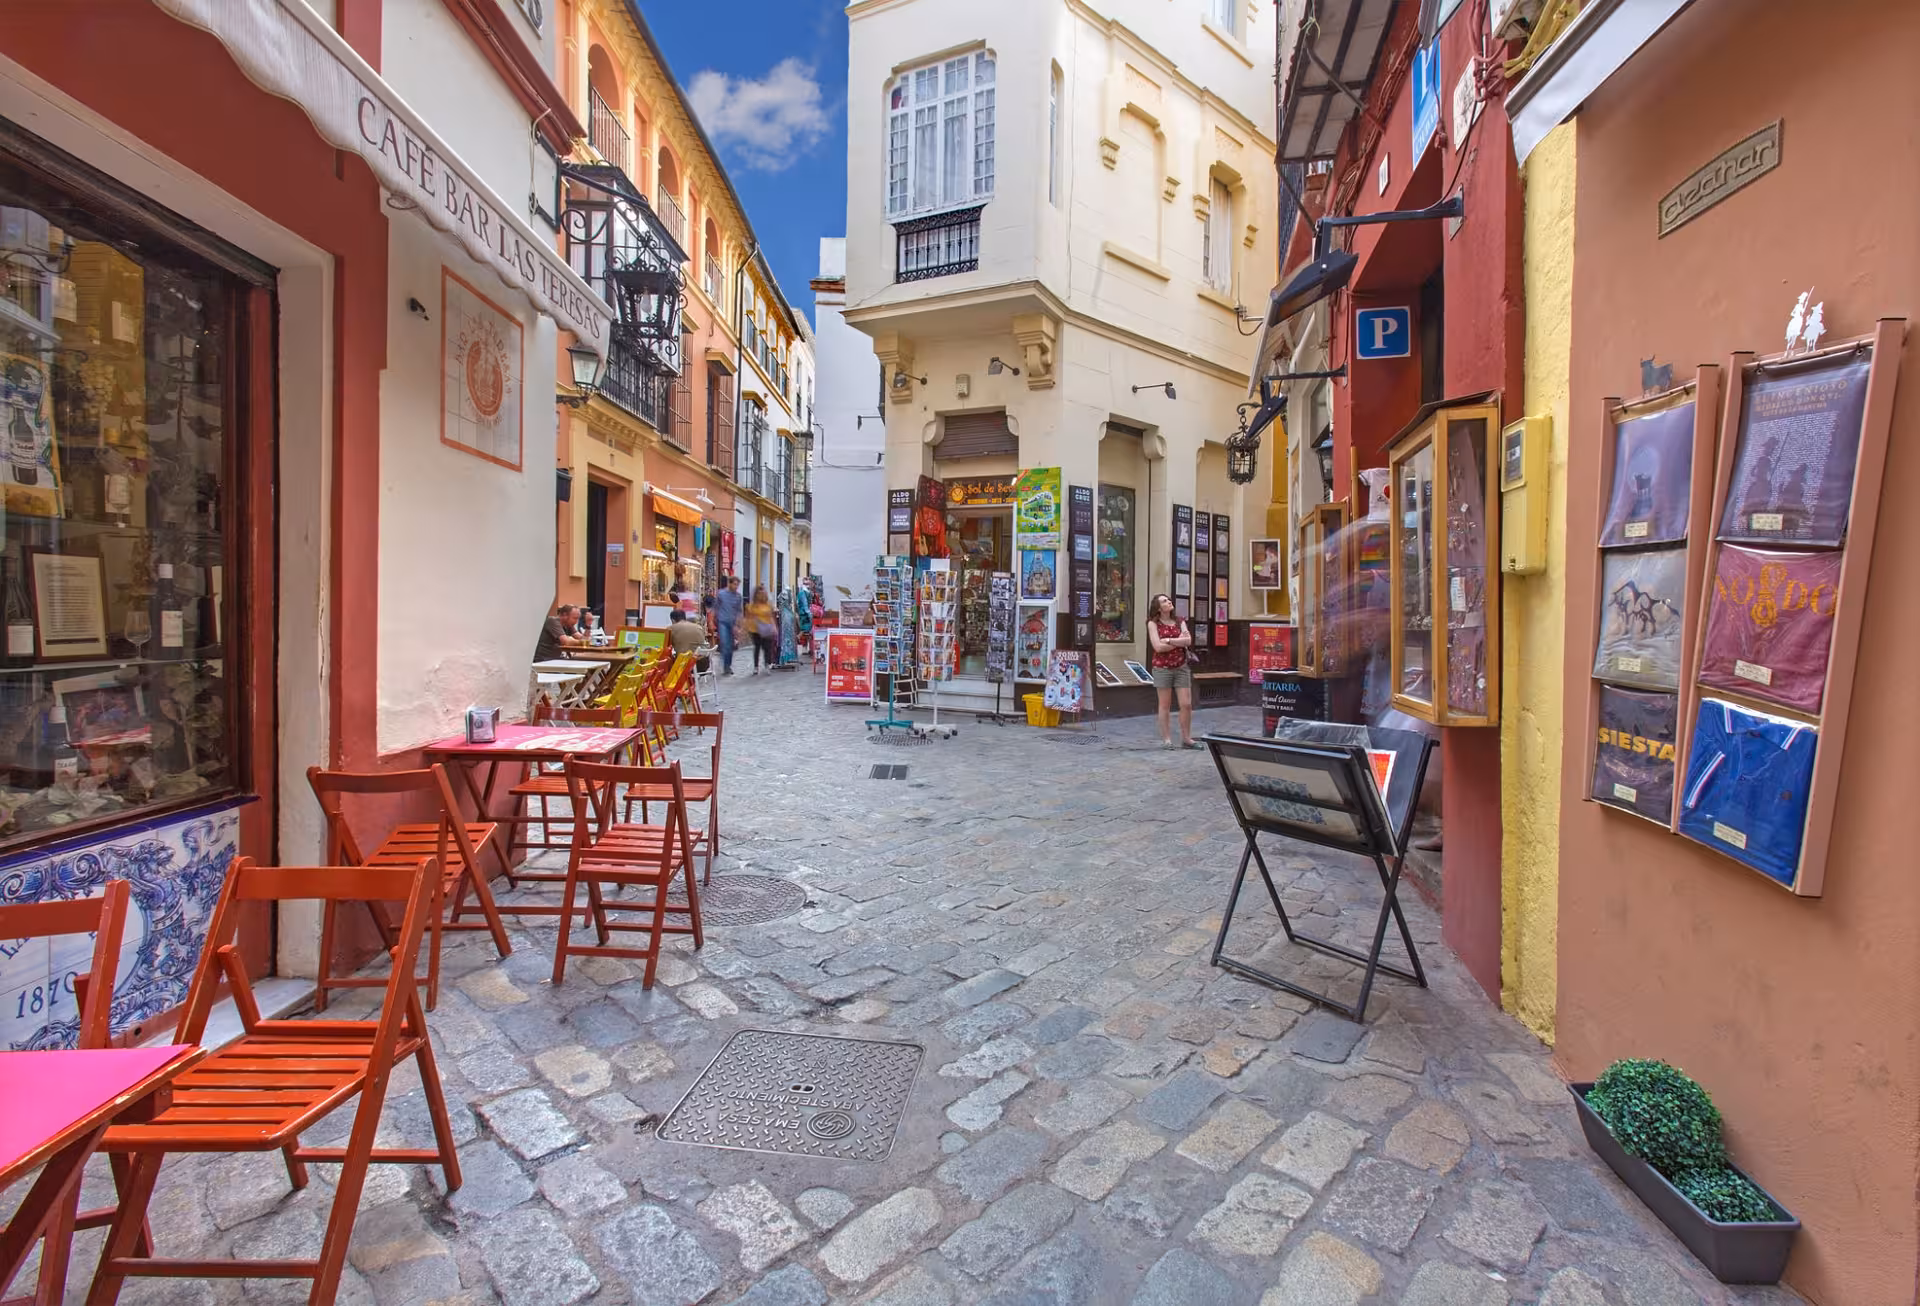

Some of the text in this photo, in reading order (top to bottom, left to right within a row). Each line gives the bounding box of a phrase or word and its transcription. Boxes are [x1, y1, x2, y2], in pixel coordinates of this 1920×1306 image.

[357, 96, 601, 340] CAFÉ BAR LAS TERESAS
[1369, 316, 1399, 350] P
[967, 482, 982, 495] Sol
[1599, 727, 1676, 762] SIESTA
[727, 1089, 866, 1112] ABASTECIMIENTO
[718, 1111, 801, 1129] EMASESA
